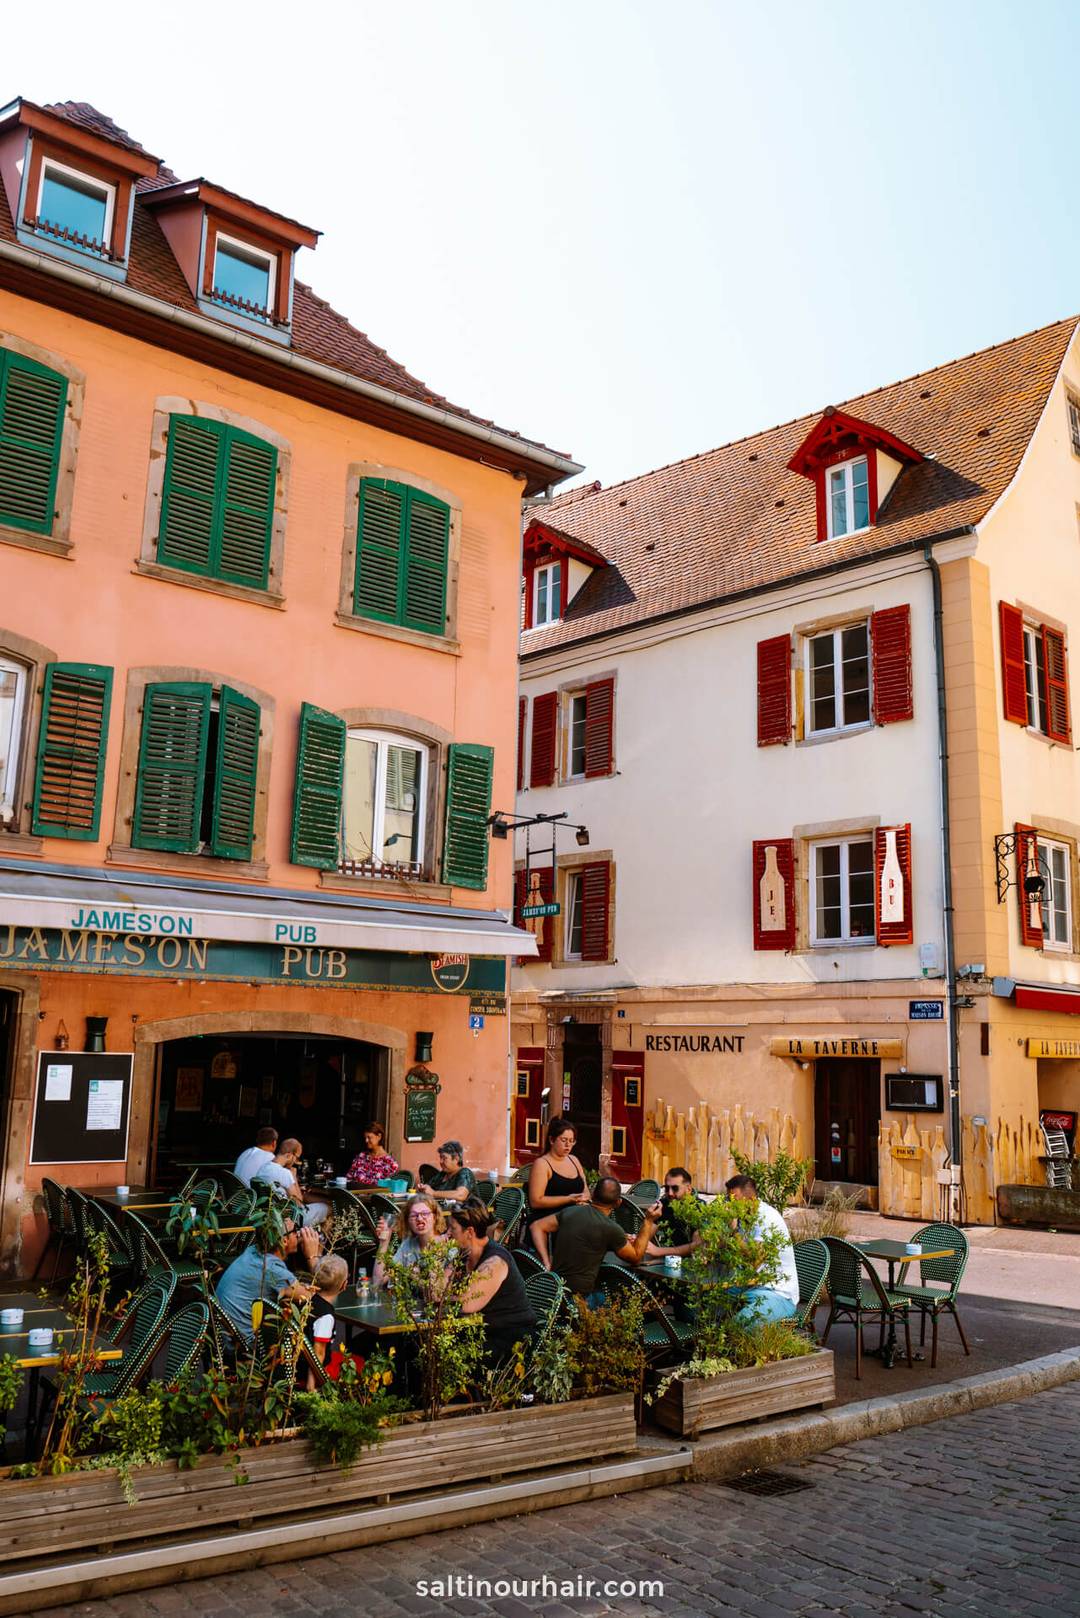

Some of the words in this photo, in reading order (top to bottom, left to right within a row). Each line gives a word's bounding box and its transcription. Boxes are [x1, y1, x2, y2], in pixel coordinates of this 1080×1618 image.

[71, 909, 193, 935] JAMES'ON
[275, 923, 317, 943] PUB
[0, 925, 210, 971] JAMES'ON
[280, 946, 348, 979] PUB
[473, 1016, 480, 1028] 2
[645, 1035, 745, 1053] RESTAURANT
[789, 1040, 802, 1054] LA
[814, 1040, 879, 1056] TAVERNE
[1040, 1041, 1049, 1055] LA
